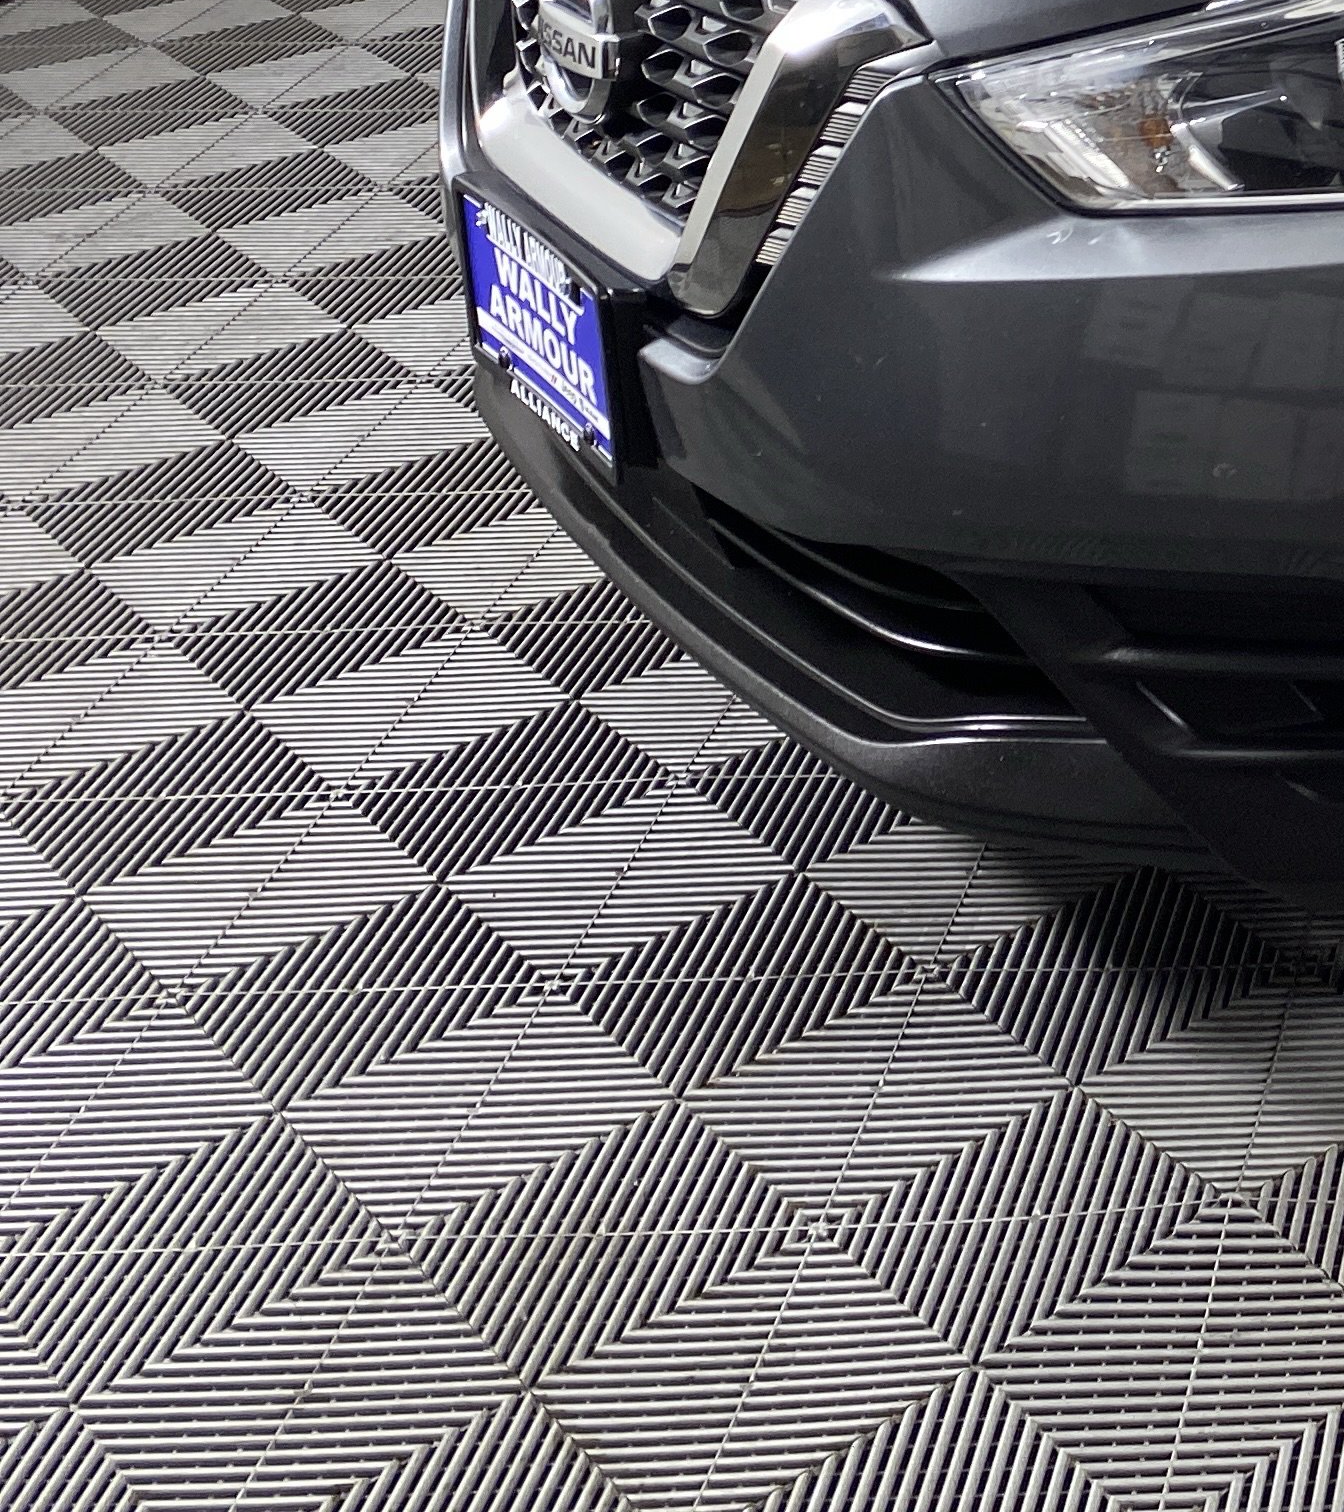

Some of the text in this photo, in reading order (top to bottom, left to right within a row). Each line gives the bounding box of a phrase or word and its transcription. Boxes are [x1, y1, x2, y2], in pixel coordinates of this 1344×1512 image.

[490, 284, 598, 406] ARMOUR
[493, 247, 578, 345] WALLY
[510, 378, 581, 451] ALLIANCE
